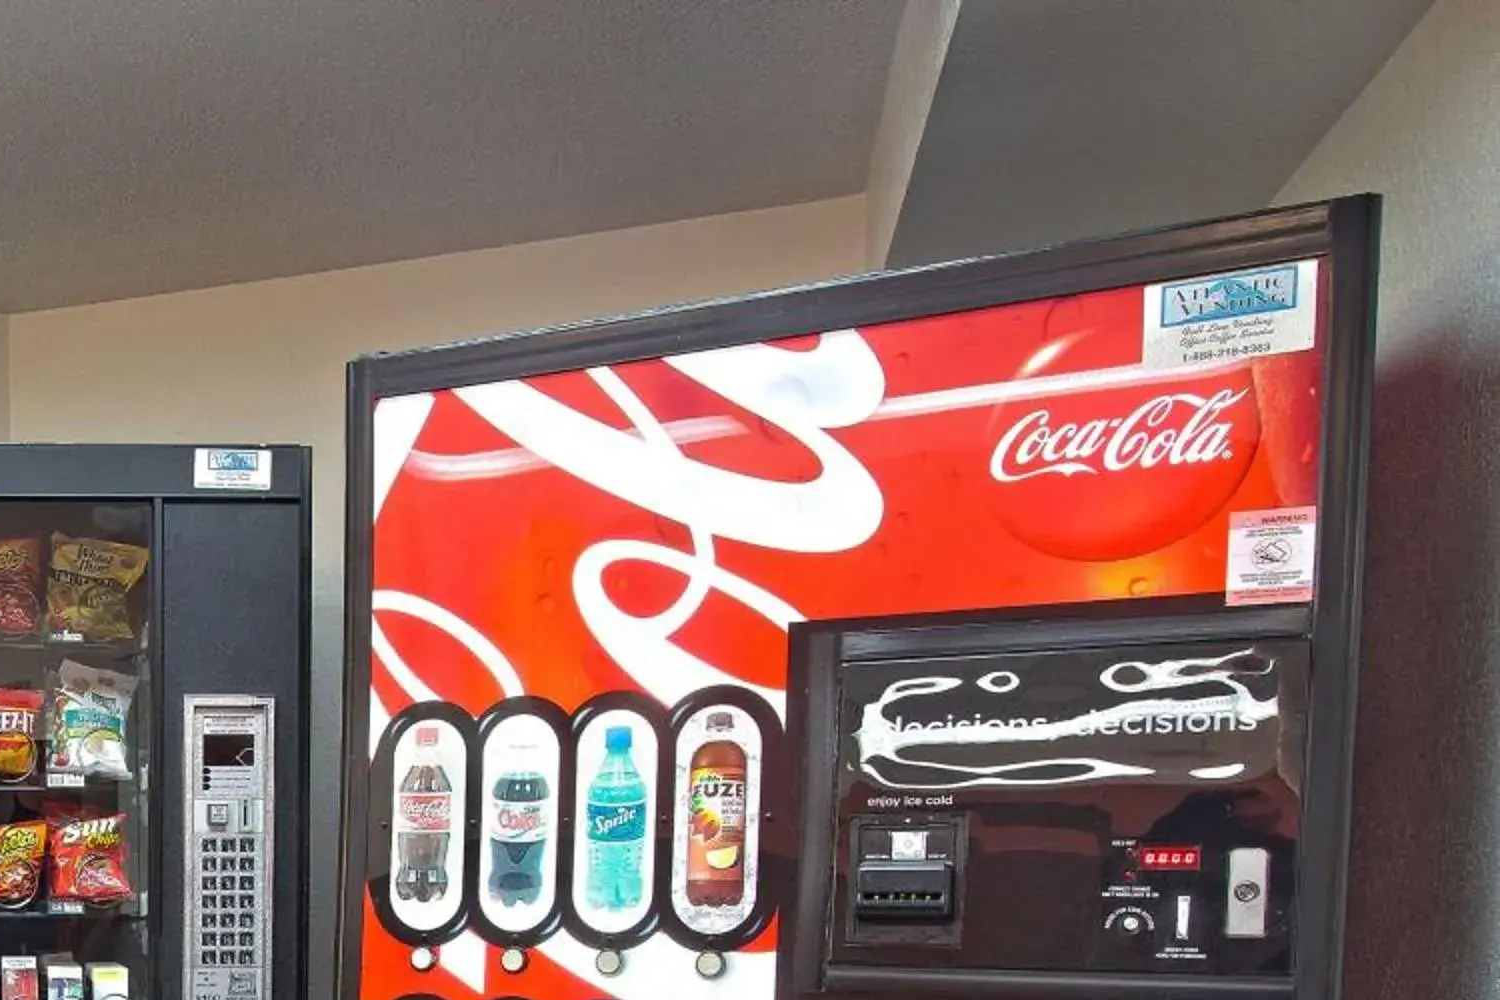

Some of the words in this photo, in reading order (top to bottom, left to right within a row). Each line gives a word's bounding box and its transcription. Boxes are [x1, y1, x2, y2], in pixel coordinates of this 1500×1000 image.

[1077, 709, 1258, 737] decisions
[866, 796, 901, 808] enjoy
[903, 796, 923, 807] ice
[925, 795, 954, 806] cold
[594, 807, 637, 834] Sprite
